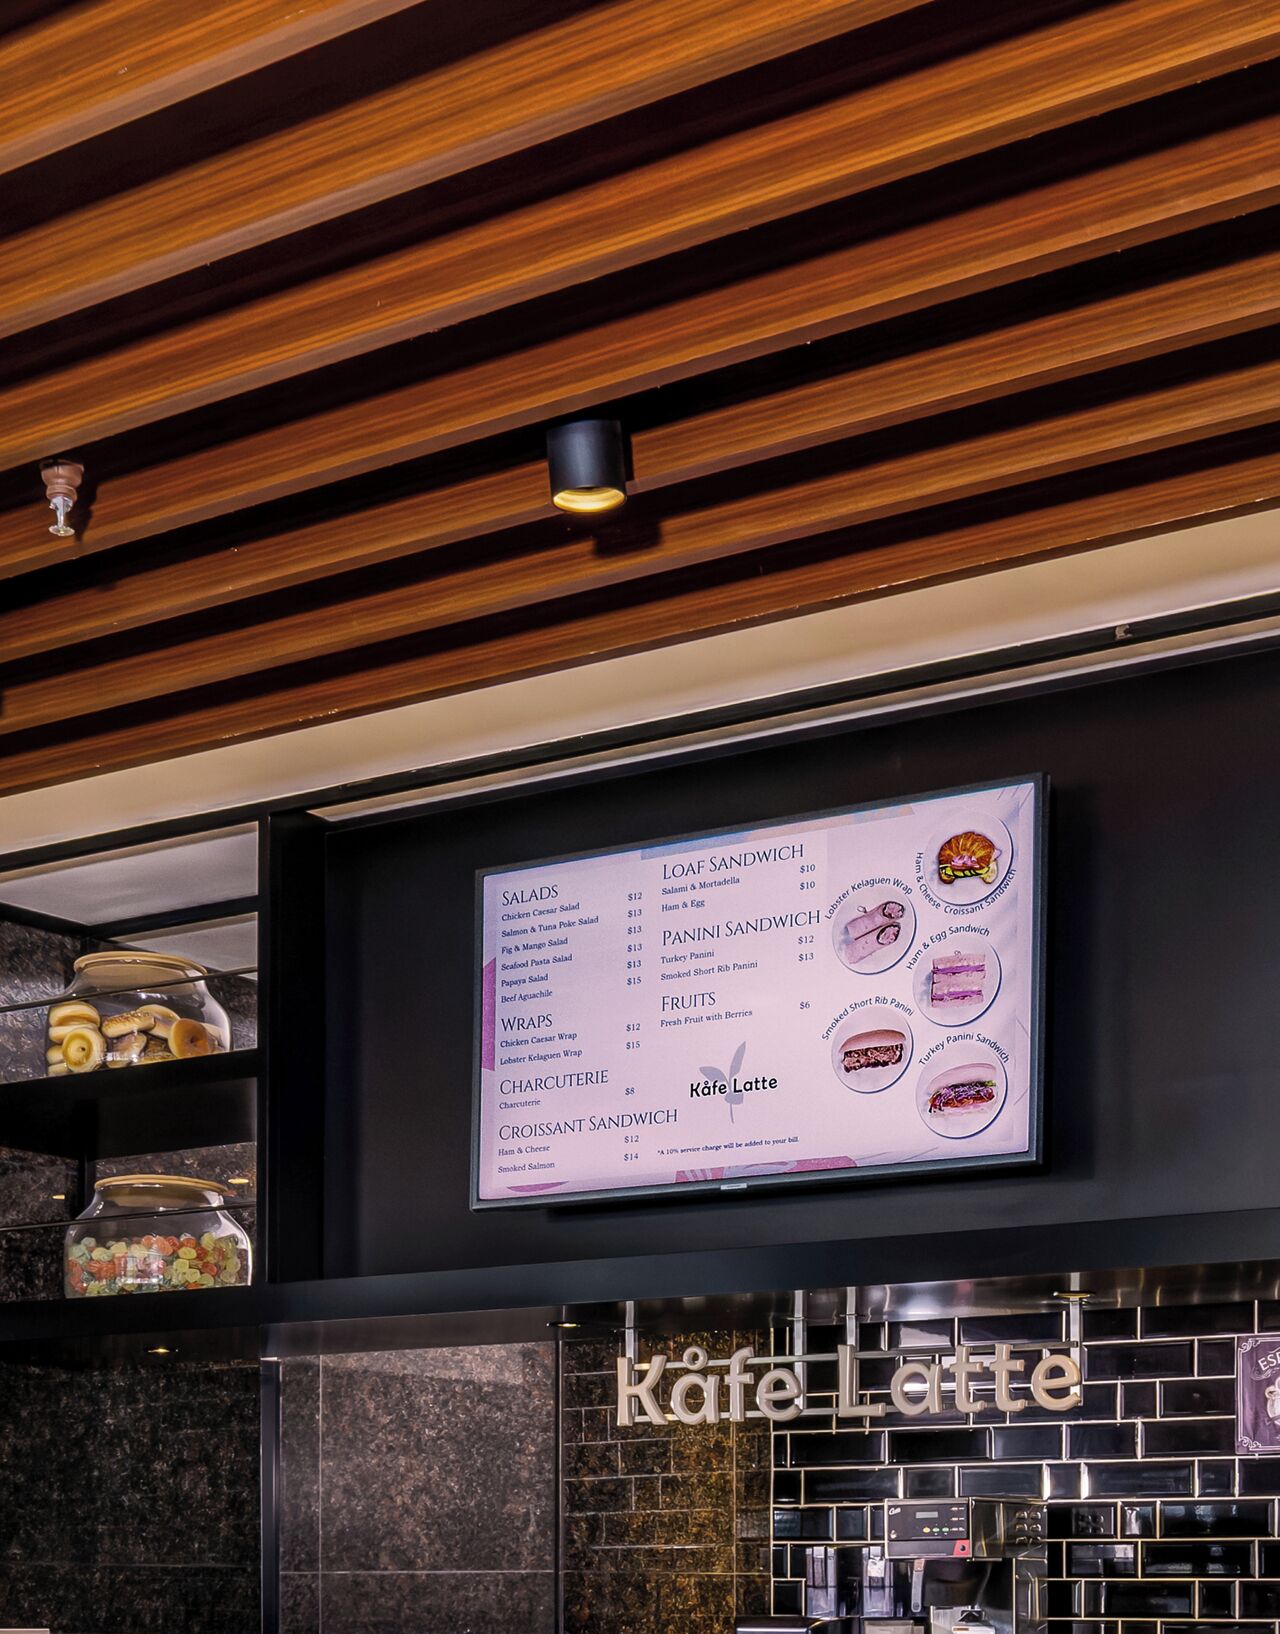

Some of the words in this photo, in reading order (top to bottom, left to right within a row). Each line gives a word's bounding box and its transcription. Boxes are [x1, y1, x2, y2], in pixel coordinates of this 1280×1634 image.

[663, 860, 705, 880] LOAF
[709, 844, 804, 872] SANDWICH
[800, 864, 816, 874] $10
[915, 852, 924, 875] Ham
[661, 884, 688, 896] Salami
[690, 883, 697, 892] &
[698, 876, 740, 890] Mortadella
[800, 881, 816, 891] $10
[985, 868, 1017, 907] Sandwich
[502, 885, 559, 906] SALADS
[627, 892, 642, 901] $12
[824, 889, 850, 920] Lobster
[851, 877, 891, 893] Kelaguen
[893, 877, 913, 896] Wrap
[919, 885, 942, 910] Cheese
[501, 911, 531, 922] Chicken
[532, 908, 557, 918] Caesar
[559, 902, 580, 913] Salad
[627, 909, 642, 918] $13
[661, 903, 679, 912] Ham
[681, 901, 688, 909] &
[690, 900, 705, 909] Egg
[944, 904, 985, 916] Croissant
[501, 927, 529, 938] Salmon
[538, 923, 557, 933] Tuna
[559, 920, 576, 930] Poke
[578, 916, 599, 927] Salad
[627, 926, 642, 935] $13
[663, 925, 720, 946] PANINI
[725, 910, 820, 937] SANDWICH
[501, 946, 513, 955] Fig
[522, 941, 546, 951] Mango
[548, 937, 568, 947] Salad
[627, 943, 642, 953] $13
[798, 935, 814, 945] $12
[906, 948, 924, 971] Ham
[922, 941, 930, 950] &
[929, 931, 948, 945] Egg
[948, 924, 990, 938] Sandwich
[501, 960, 529, 971] Seafood
[530, 958, 551, 967] Pasta
[552, 954, 573, 964] Salad
[627, 960, 642, 969] $13
[660, 954, 688, 964] Turkey
[690, 950, 715, 960] Panini
[798, 952, 814, 962] $13
[660, 970, 691, 981] Smoked
[693, 967, 715, 977] Short
[717, 964, 731, 974] Rib
[732, 960, 758, 971] Panini
[501, 978, 527, 988] Papaya
[528, 973, 549, 983] Salad
[627, 977, 642, 986] $15
[501, 994, 517, 1004] Beef
[517, 989, 553, 1001] Aguachile
[662, 992, 716, 1012] FRUITS
[800, 1001, 811, 1010] $6
[501, 1013, 553, 1032] WRAPS
[660, 1018, 682, 1028] Fresh
[684, 1015, 704, 1025] Fruit
[706, 1012, 723, 1022] with
[725, 1009, 753, 1019] Berries
[821, 1008, 849, 1041] Smoked
[849, 998, 873, 1012] Short
[875, 996, 889, 1005] Rib
[890, 998, 915, 1017] Panini
[626, 1023, 641, 1033] $12
[500, 1038, 529, 1048] Chicken
[531, 1035, 556, 1044] Caesar
[557, 1032, 577, 1042] Wrap
[626, 1041, 641, 1050] $15
[500, 1056, 527, 1066] Lobster
[528, 1051, 561, 1063] Kelaguen
[563, 1048, 583, 1058] Wrap
[918, 1041, 945, 1066] Turkey
[946, 1033, 974, 1045] Panini
[975, 1033, 1010, 1064] Sandwich
[499, 1070, 609, 1095] CHARCUTERIE
[690, 1080, 727, 1098] Kåfe
[733, 1076, 778, 1093] Latte
[625, 1087, 635, 1096] $8
[499, 1098, 541, 1110] Charcuterie
[499, 1118, 586, 1141] CROISSANT
[589, 1109, 678, 1132] SANDWICH
[624, 1135, 639, 1144] $12
[680, 1146, 701, 1154] service
[702, 1144, 723, 1153] charge
[744, 1139, 763, 1147] added
[772, 1138, 787, 1146] your
[498, 1147, 515, 1157] Ham
[516, 1146, 523, 1155] &
[525, 1144, 551, 1153] Cheese
[624, 1153, 639, 1161] $14
[498, 1163, 526, 1174] Smoked
[528, 1161, 555, 1171] Salmon
[837, 1343, 1082, 1417] Latte
